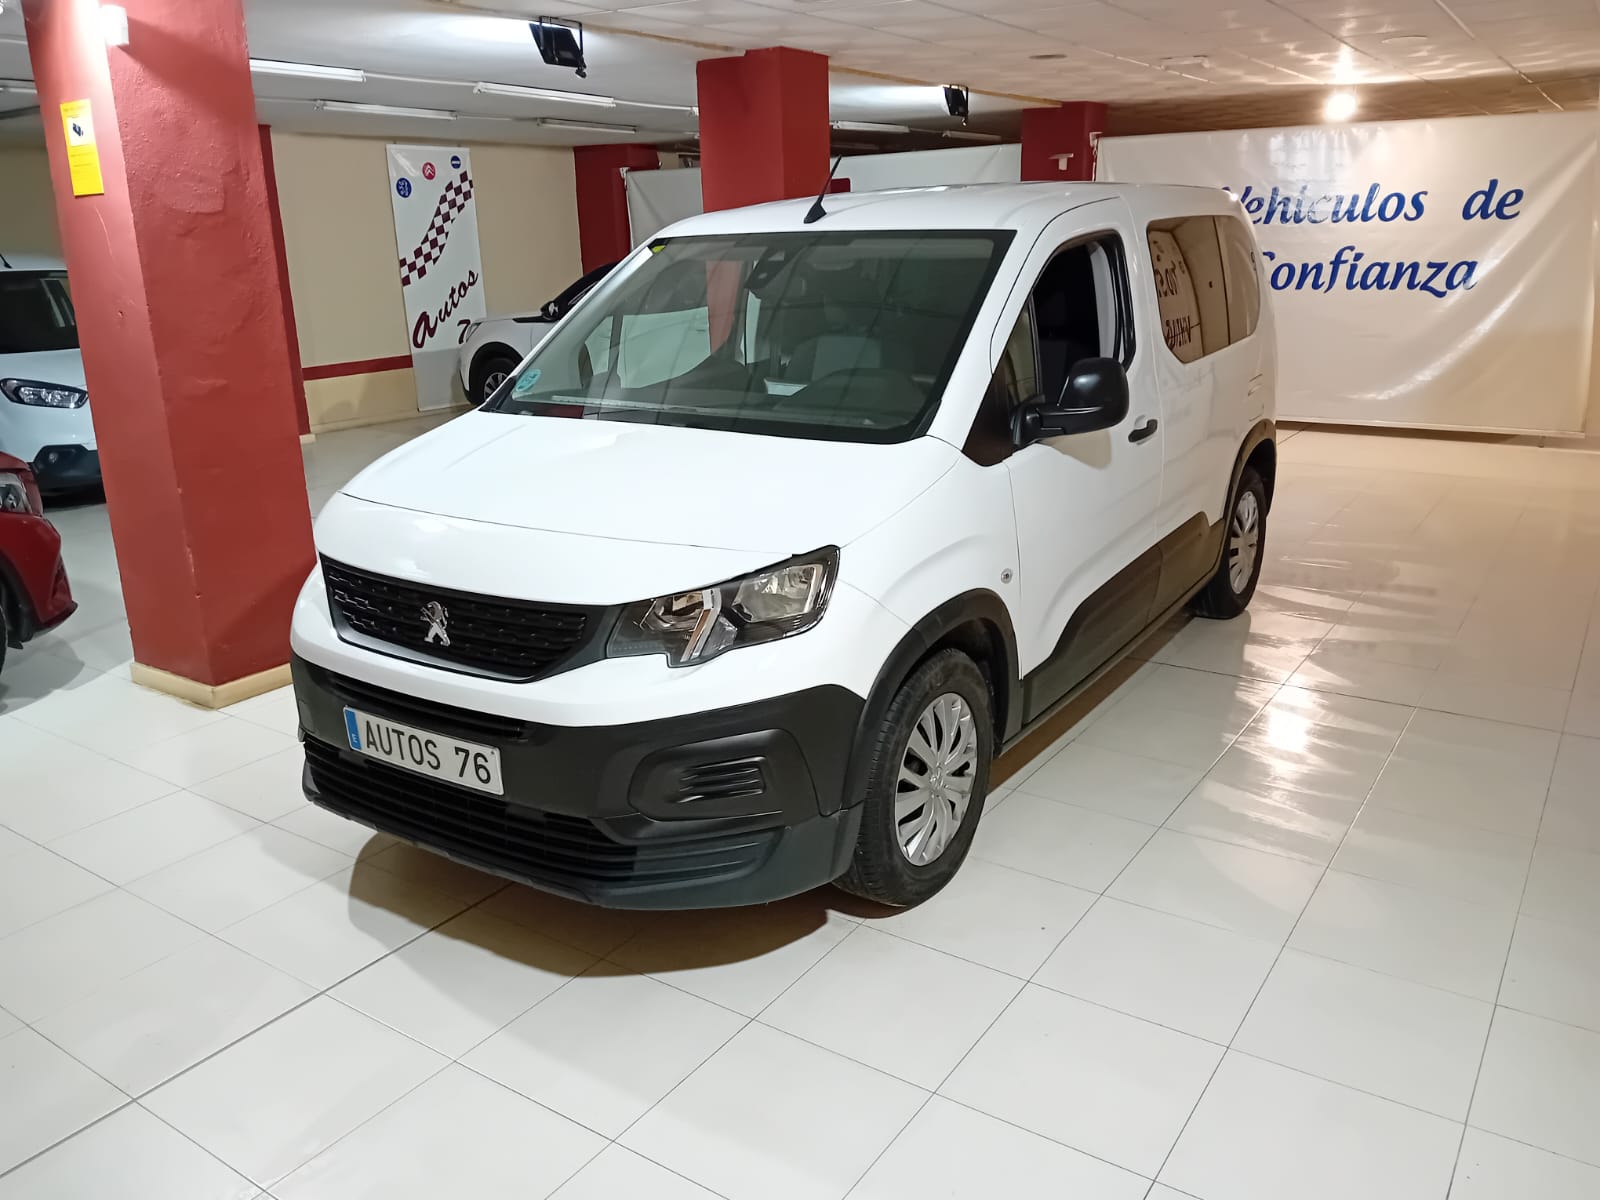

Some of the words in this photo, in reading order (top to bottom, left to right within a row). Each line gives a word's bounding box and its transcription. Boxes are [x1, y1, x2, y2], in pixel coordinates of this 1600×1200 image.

[1462, 178, 1524, 221] de
[1262, 245, 1478, 298] onfianza
[457, 318, 471, 345] 7
[366, 720, 441, 771] AUTOS
[454, 746, 491, 784] 76
